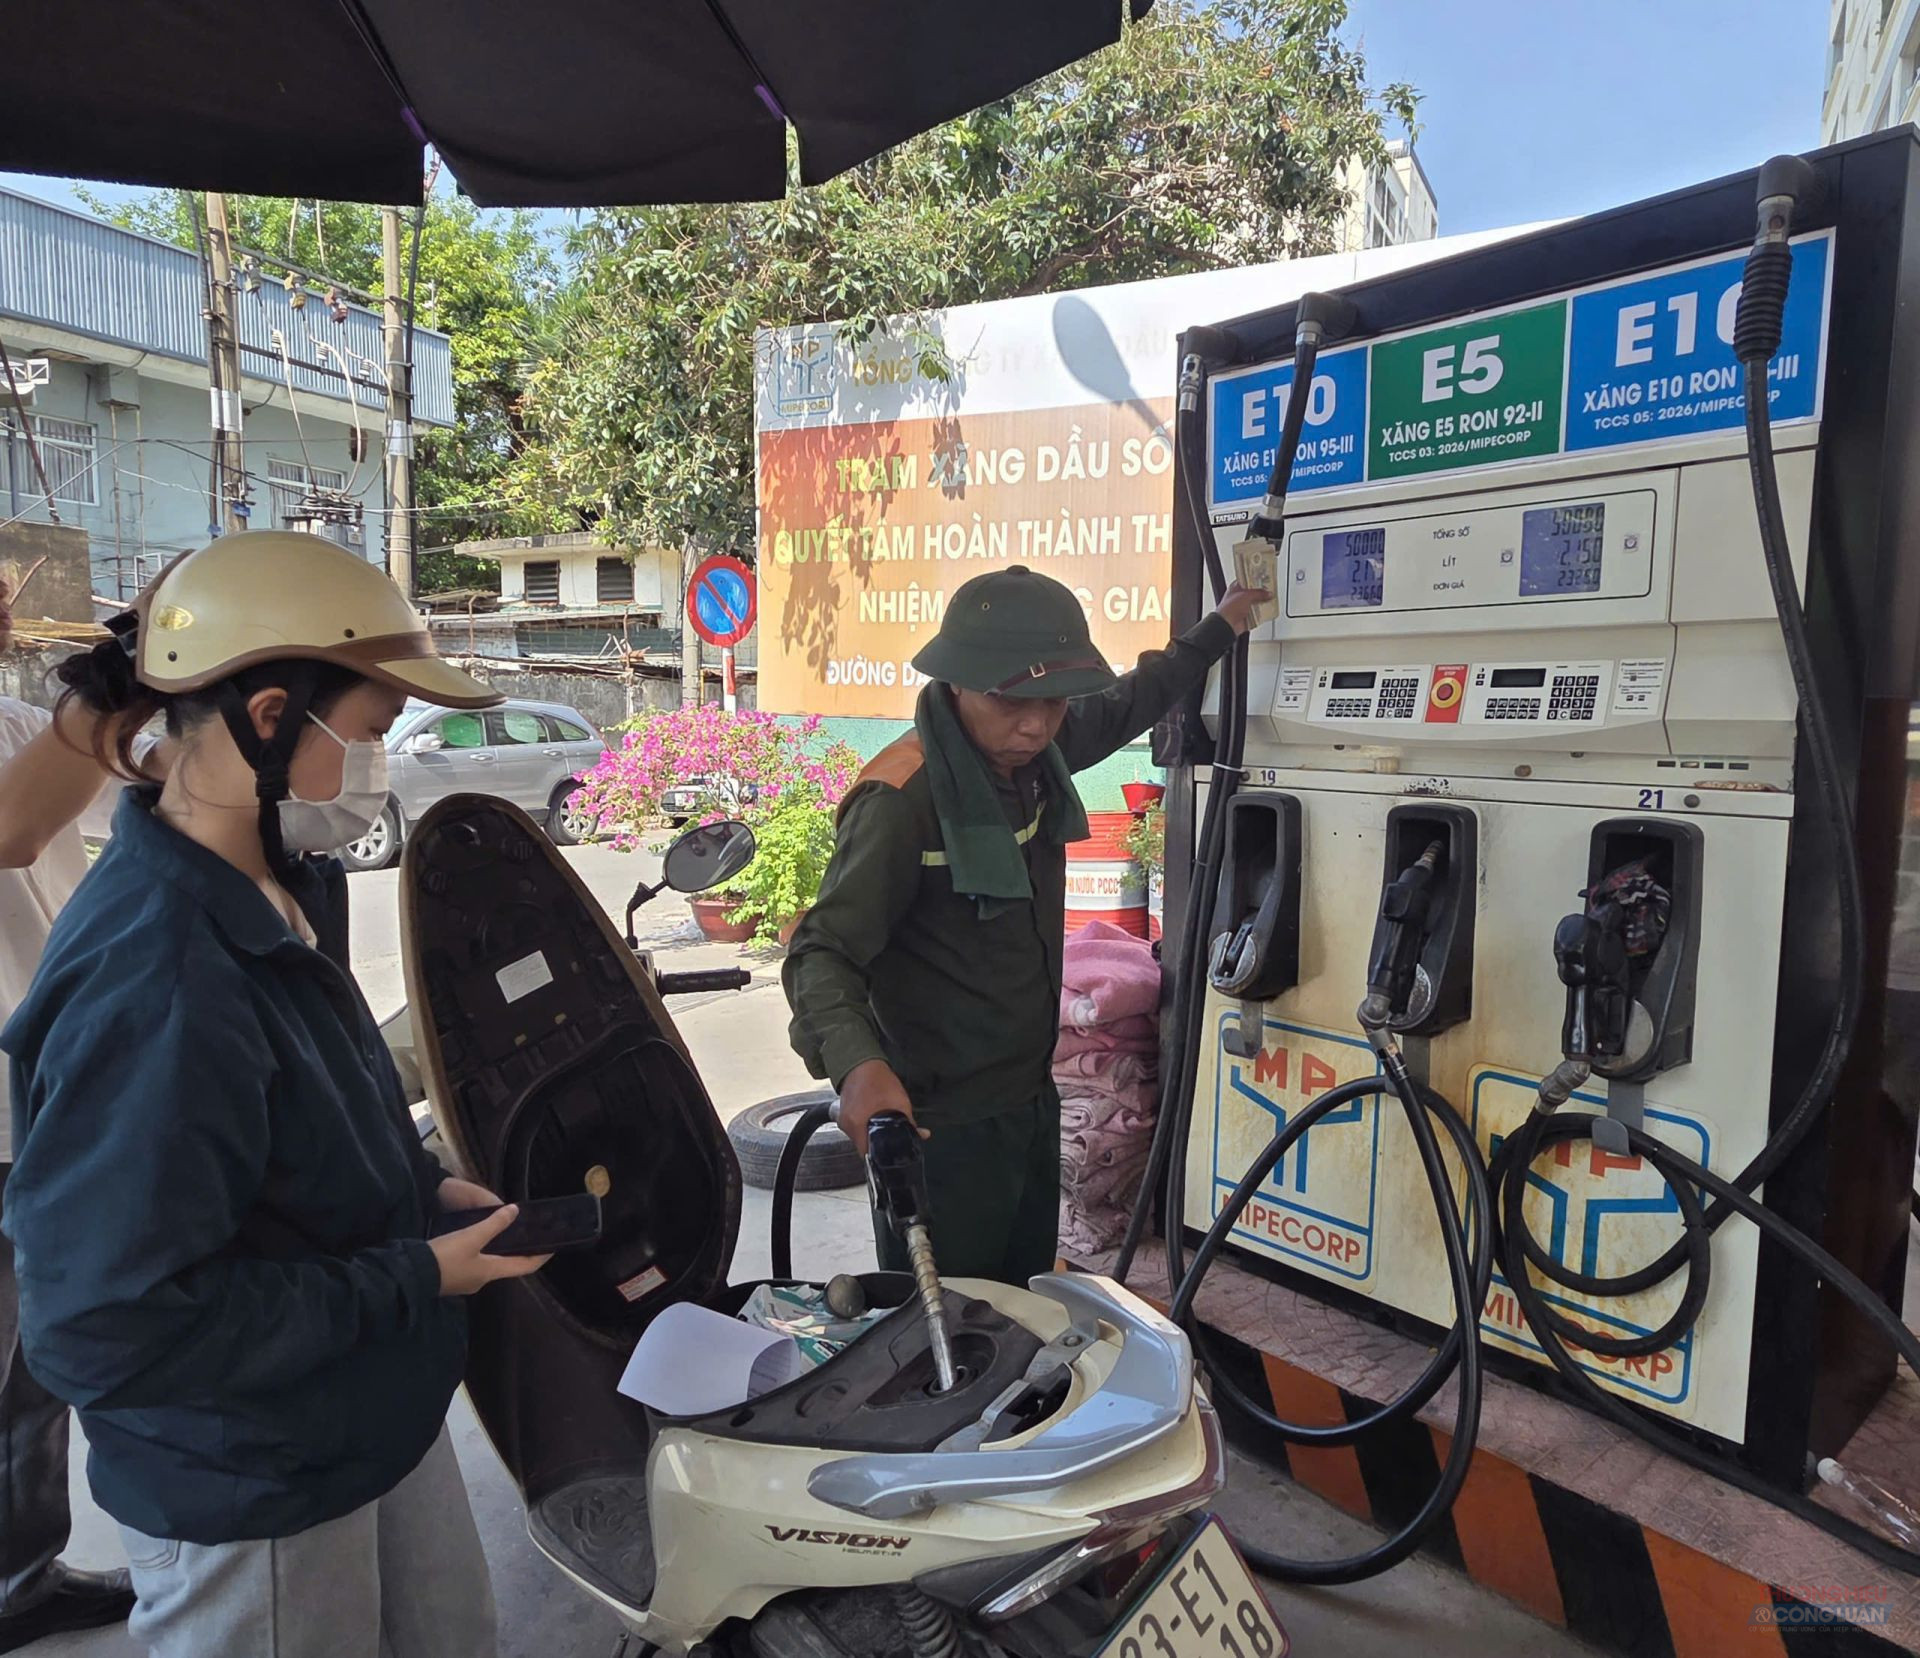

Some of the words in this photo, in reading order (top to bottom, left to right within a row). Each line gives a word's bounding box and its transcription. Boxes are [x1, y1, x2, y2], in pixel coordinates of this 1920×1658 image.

[1422, 335, 1504, 403] E5
[1582, 383, 1642, 413] XĂNG
[1648, 375, 1683, 402] E10
[1689, 365, 1736, 395] RON
[1767, 354, 1799, 381] -III
[1242, 375, 1337, 439] E10
[1381, 421, 1430, 447] XĂNG
[1435, 416, 1454, 438] E5
[1459, 408, 1498, 434] RON
[1504, 400, 1543, 426] 92-II
[1594, 414, 1629, 431] TCCS
[1633, 412, 1654, 424] 05:
[1658, 390, 1780, 421] 2026/MIPECP
[835, 455, 917, 502] TRẠM
[927, 442, 1026, 488] XĂNG
[1037, 424, 1109, 483] DẦU
[1223, 452, 1259, 475] XĂNG
[1263, 449, 1275, 467] E1
[1293, 442, 1317, 463] ON
[1320, 435, 1354, 458] 95-III
[1389, 449, 1416, 462] TCCS
[1419, 447, 1435, 458] 03:
[1438, 430, 1531, 456] 2026/MIPECORP
[1231, 474, 1253, 488] TCCS
[1255, 474, 1268, 484] 05:
[774, 513, 853, 565] QUYẾT
[859, 517, 914, 561] TÂM
[924, 512, 1008, 560] HOÀN
[1018, 507, 1121, 559] THÀNH
[1442, 555, 1456, 567] LÍT
[859, 581, 944, 632] NHIỆM
[827, 654, 897, 687] ĐƯỜNG
[1261, 770, 1275, 785] 19
[1638, 789, 1663, 809] 21
[764, 1524, 911, 1549] VISION
